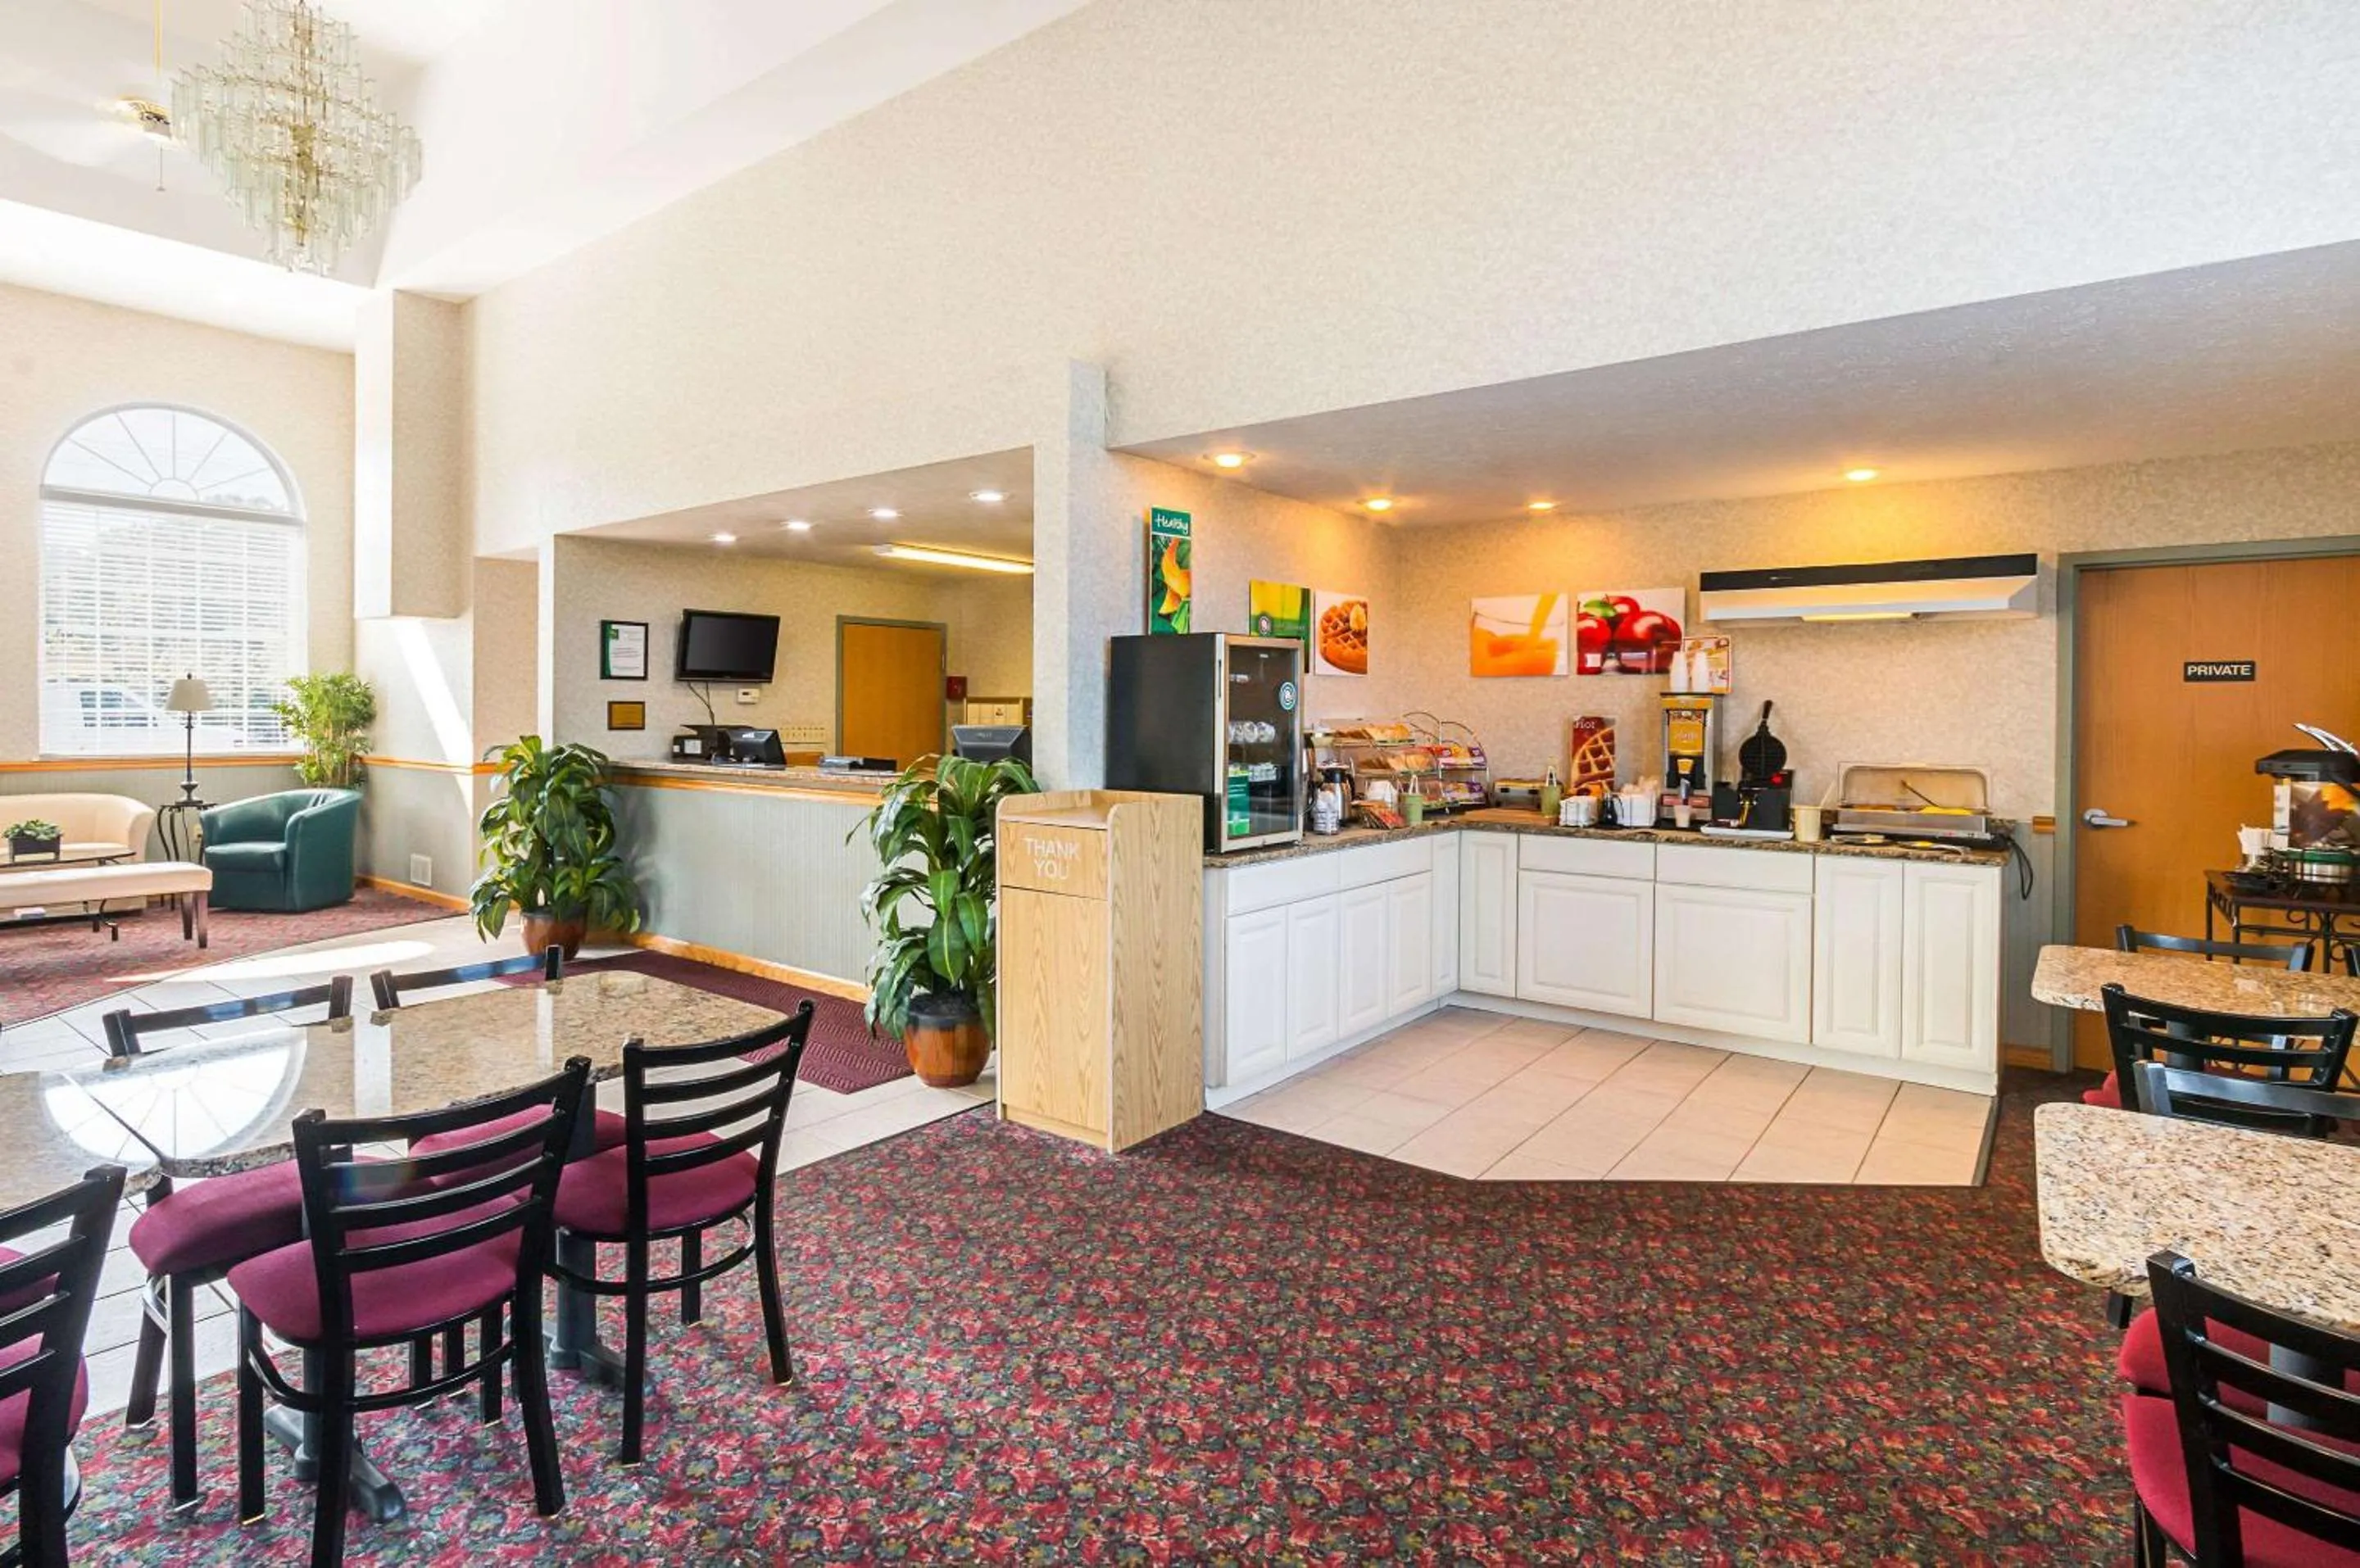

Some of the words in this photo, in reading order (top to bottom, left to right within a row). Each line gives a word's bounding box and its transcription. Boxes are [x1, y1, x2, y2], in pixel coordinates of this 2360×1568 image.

[2186, 664, 2252, 676] PRIVATE
[1023, 836, 1080, 861] THANK
[1033, 859, 1069, 881] YOU
